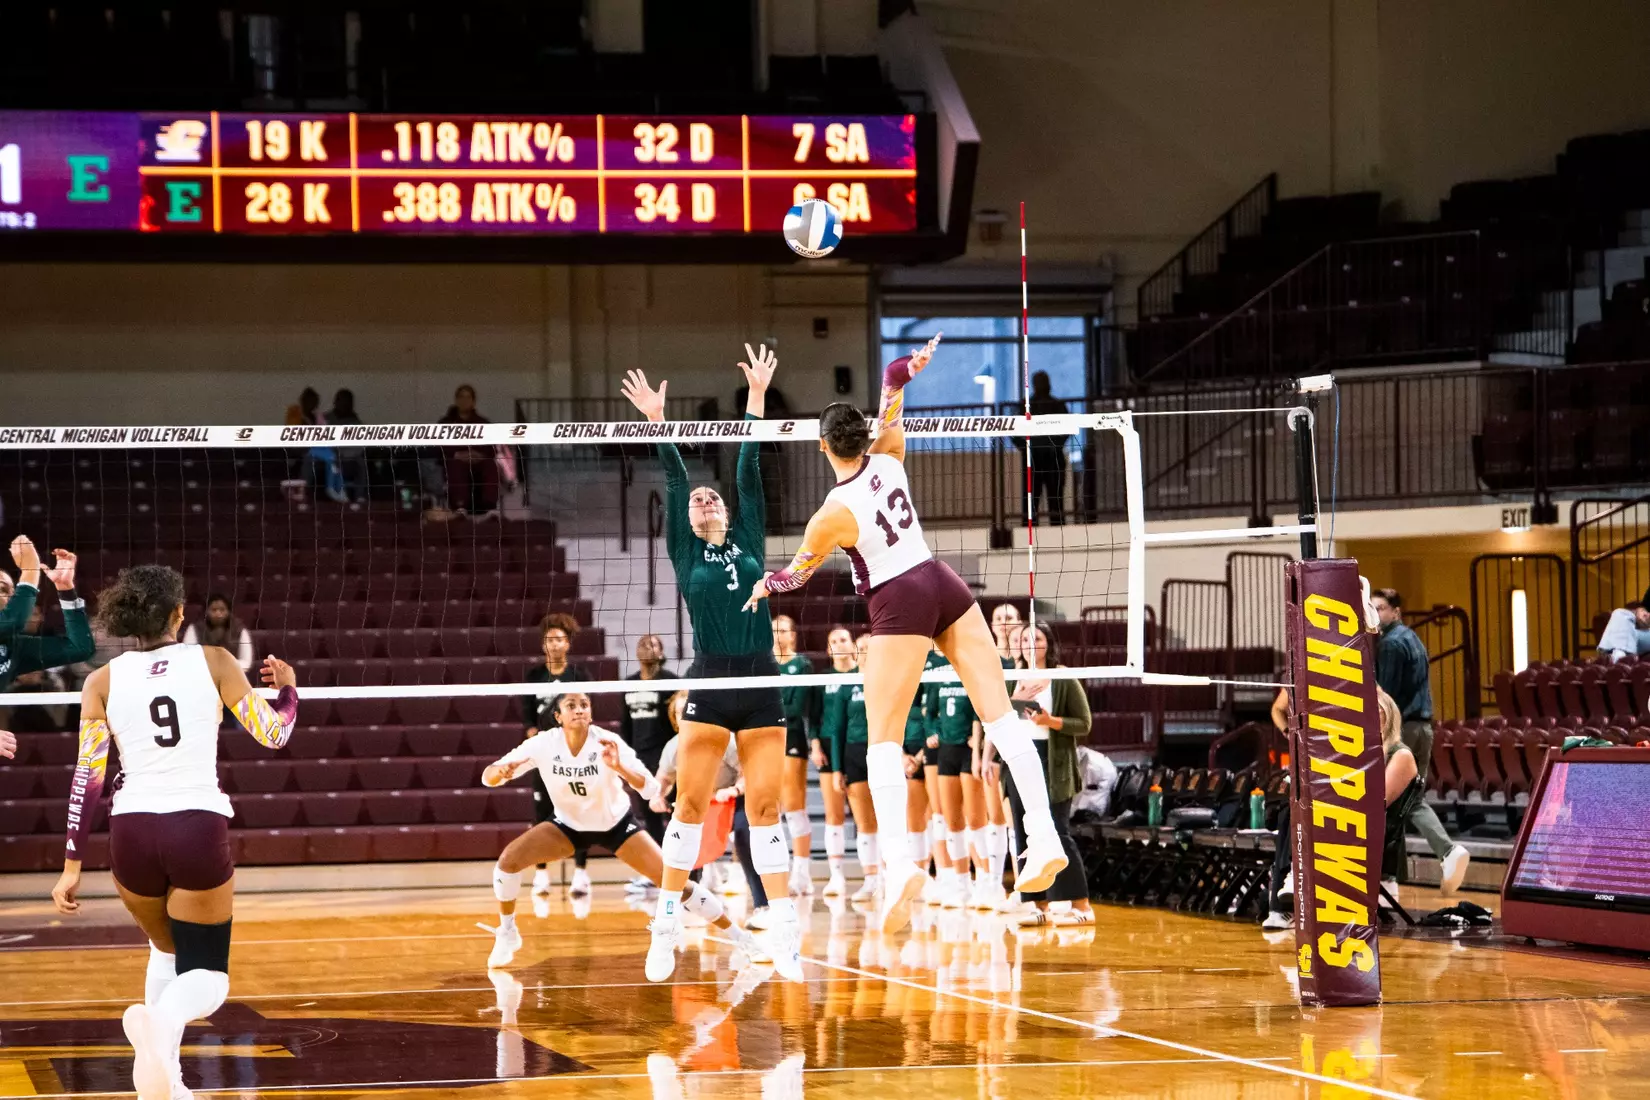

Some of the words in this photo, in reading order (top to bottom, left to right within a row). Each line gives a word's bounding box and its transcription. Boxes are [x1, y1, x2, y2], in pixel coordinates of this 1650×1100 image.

[246, 120, 290, 161] 19
[300, 120, 328, 161] K
[381, 121, 460, 162] .118
[469, 121, 575, 163] ATK%
[634, 122, 679, 163] 32
[689, 122, 714, 163] D
[793, 122, 815, 163] 7
[825, 122, 870, 163] SA
[67, 155, 109, 201] E
[166, 182, 201, 221] E
[245, 182, 293, 223] 28
[303, 182, 331, 223] K
[382, 182, 462, 223] .388
[470, 182, 577, 223] ATK%
[634, 182, 681, 223] 34
[691, 182, 716, 223] D
[827, 182, 872, 223] SA
[0, 428, 56, 444] CENTRAL
[61, 428, 128, 443] MICHIGAN
[130, 427, 209, 443] VOLLEYBALL
[280, 426, 336, 441] CENTRAL
[340, 426, 405, 441] MICHIGAN
[408, 425, 484, 440] VOLLEYBALL
[553, 423, 608, 438] CENTRAL
[612, 423, 675, 438] MICHIGAN
[678, 421, 752, 437] VOLLEYBALL
[903, 418, 938, 433] HIGAN
[942, 417, 1016, 433] VOLLEYBALL
[875, 487, 914, 548] 13
[1502, 508, 1528, 527] EXIT
[724, 563, 739, 591] 3
[149, 695, 182, 748] 9
[685, 702, 697, 715] E
[552, 764, 599, 778] EASTERN
[568, 781, 587, 797] 16
[1304, 593, 1376, 973] CHIPPEWAS
[66, 756, 92, 832] CHIPPEWAS
[1296, 823, 1304, 871] sports
